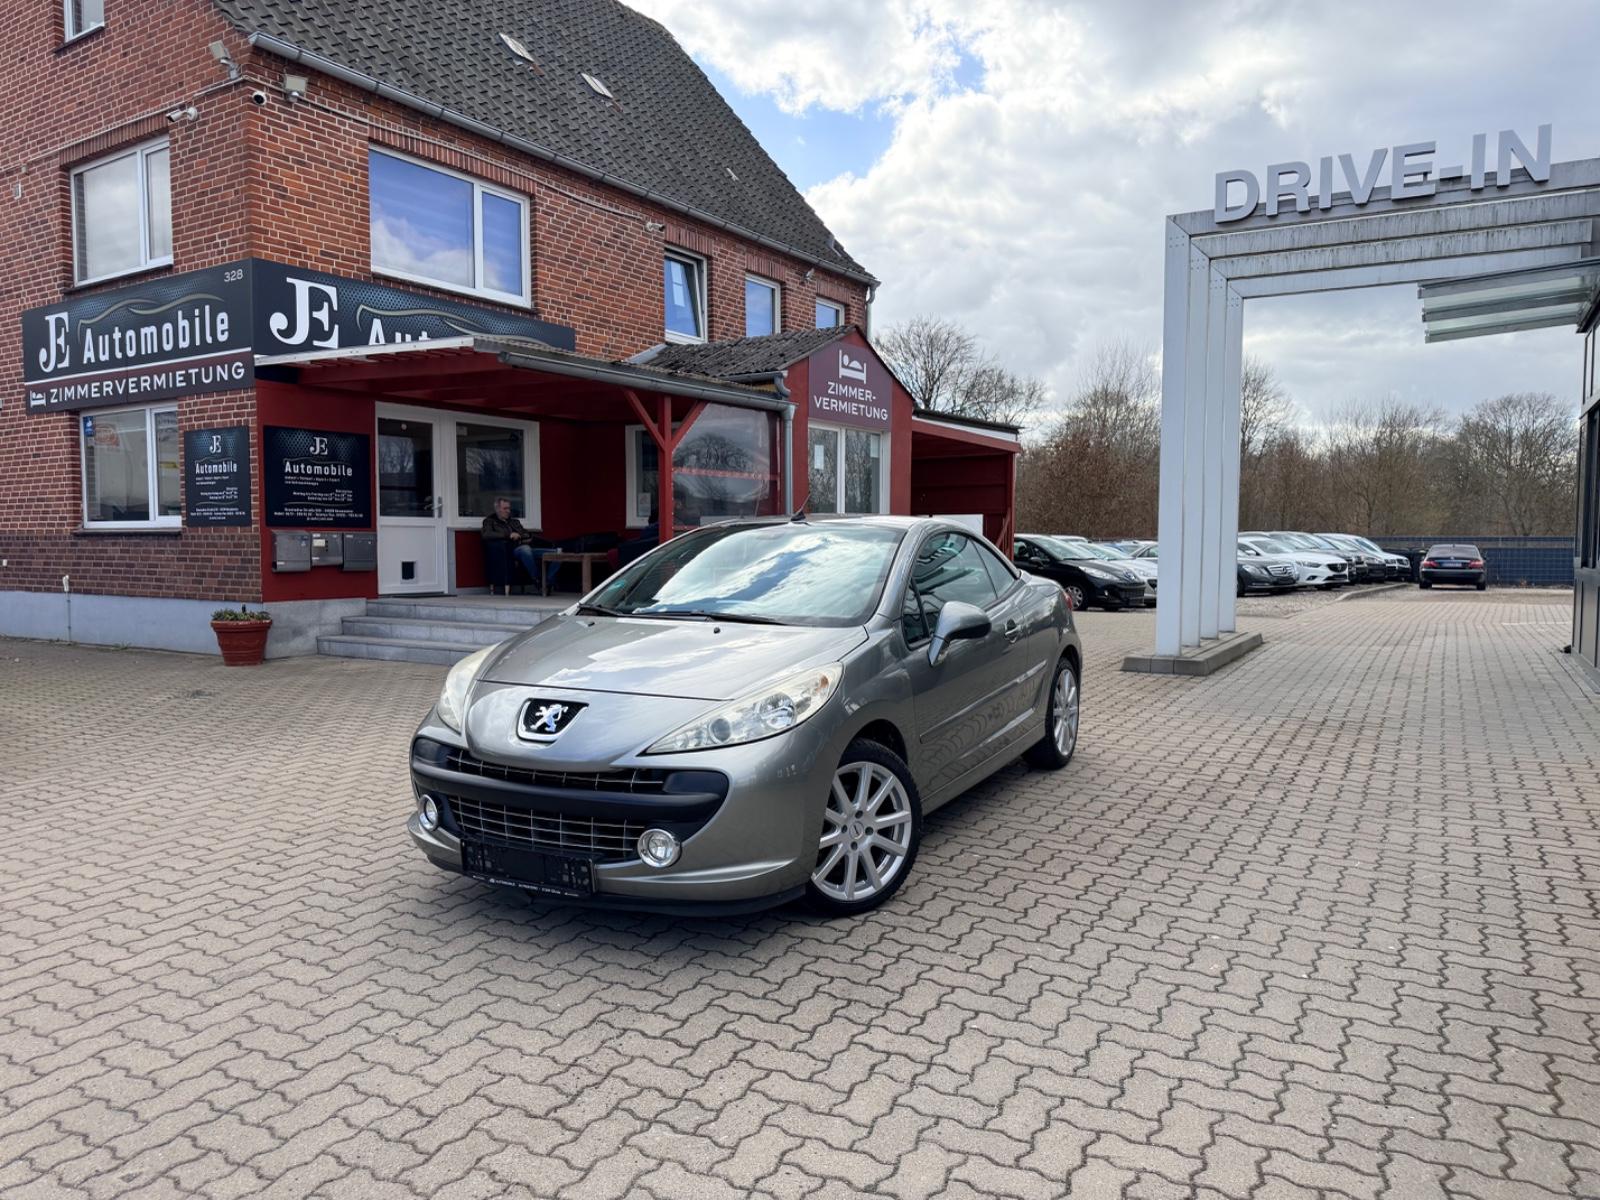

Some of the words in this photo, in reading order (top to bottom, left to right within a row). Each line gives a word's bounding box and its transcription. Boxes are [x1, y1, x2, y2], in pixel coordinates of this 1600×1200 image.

[1214, 123, 1553, 224] DRIVE-IN
[223, 268, 244, 283] 328
[83, 304, 229, 365] Automobile
[50, 361, 246, 403] ZIMMERVERMIETUNG
[827, 382, 877, 402] ZIMMER-
[813, 395, 888, 421] VERMIETUNG
[195, 461, 238, 474] Automobile
[284, 461, 353, 477] Automobile
